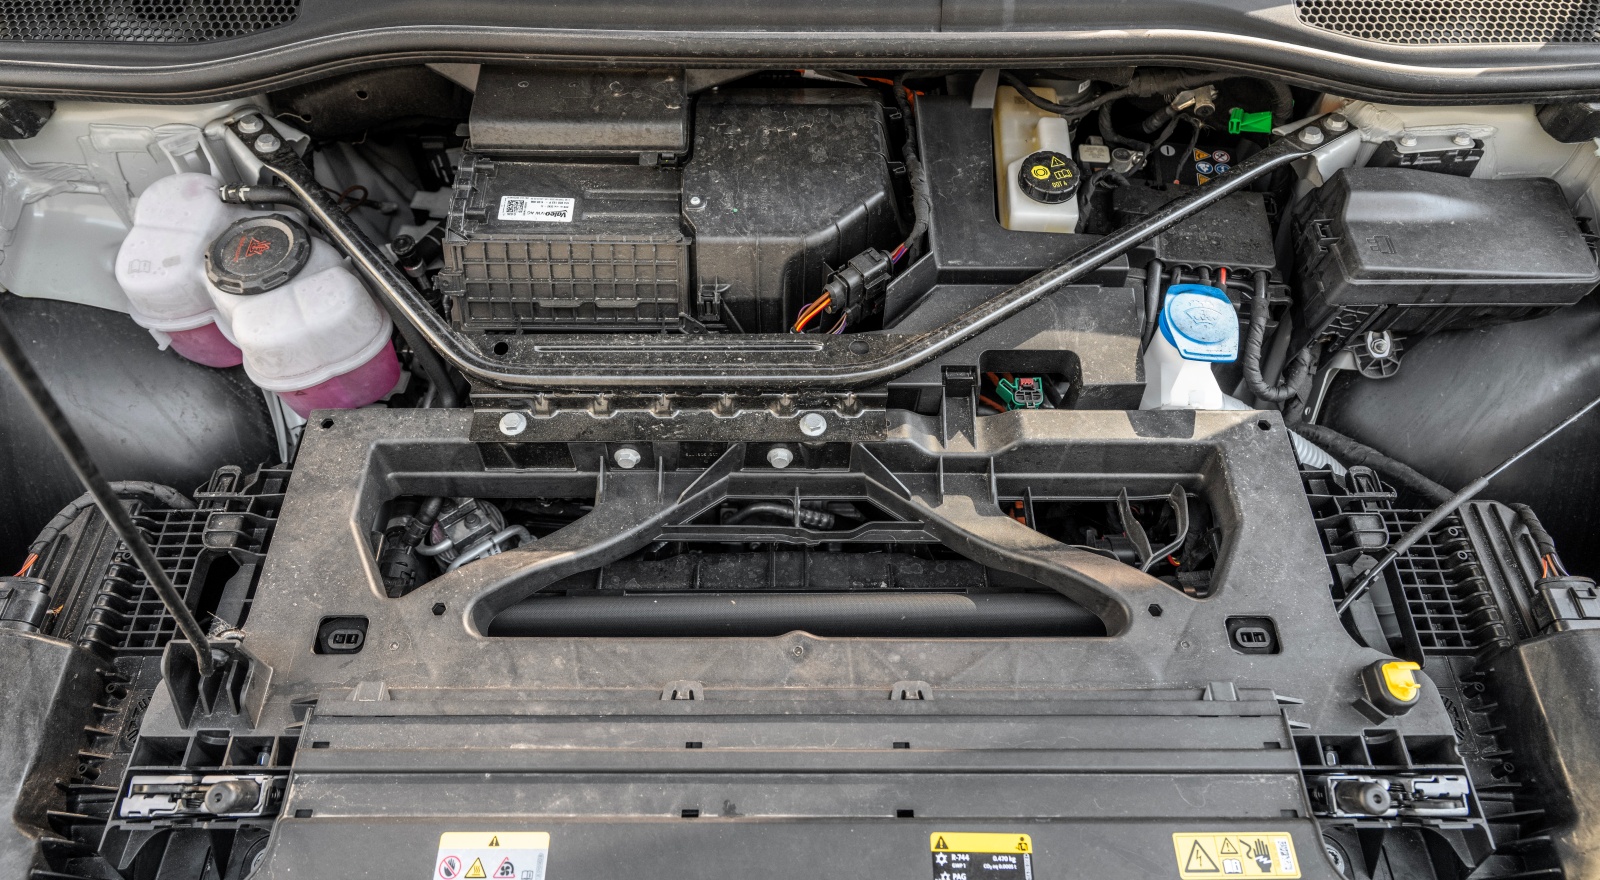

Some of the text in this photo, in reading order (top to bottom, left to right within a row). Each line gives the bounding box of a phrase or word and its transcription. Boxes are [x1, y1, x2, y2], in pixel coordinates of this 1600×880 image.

[545, 210, 567, 218] Valeo
[951, 853, 969, 861] R-744
[1009, 855, 1017, 864] kg
[952, 872, 967, 880] PAG
